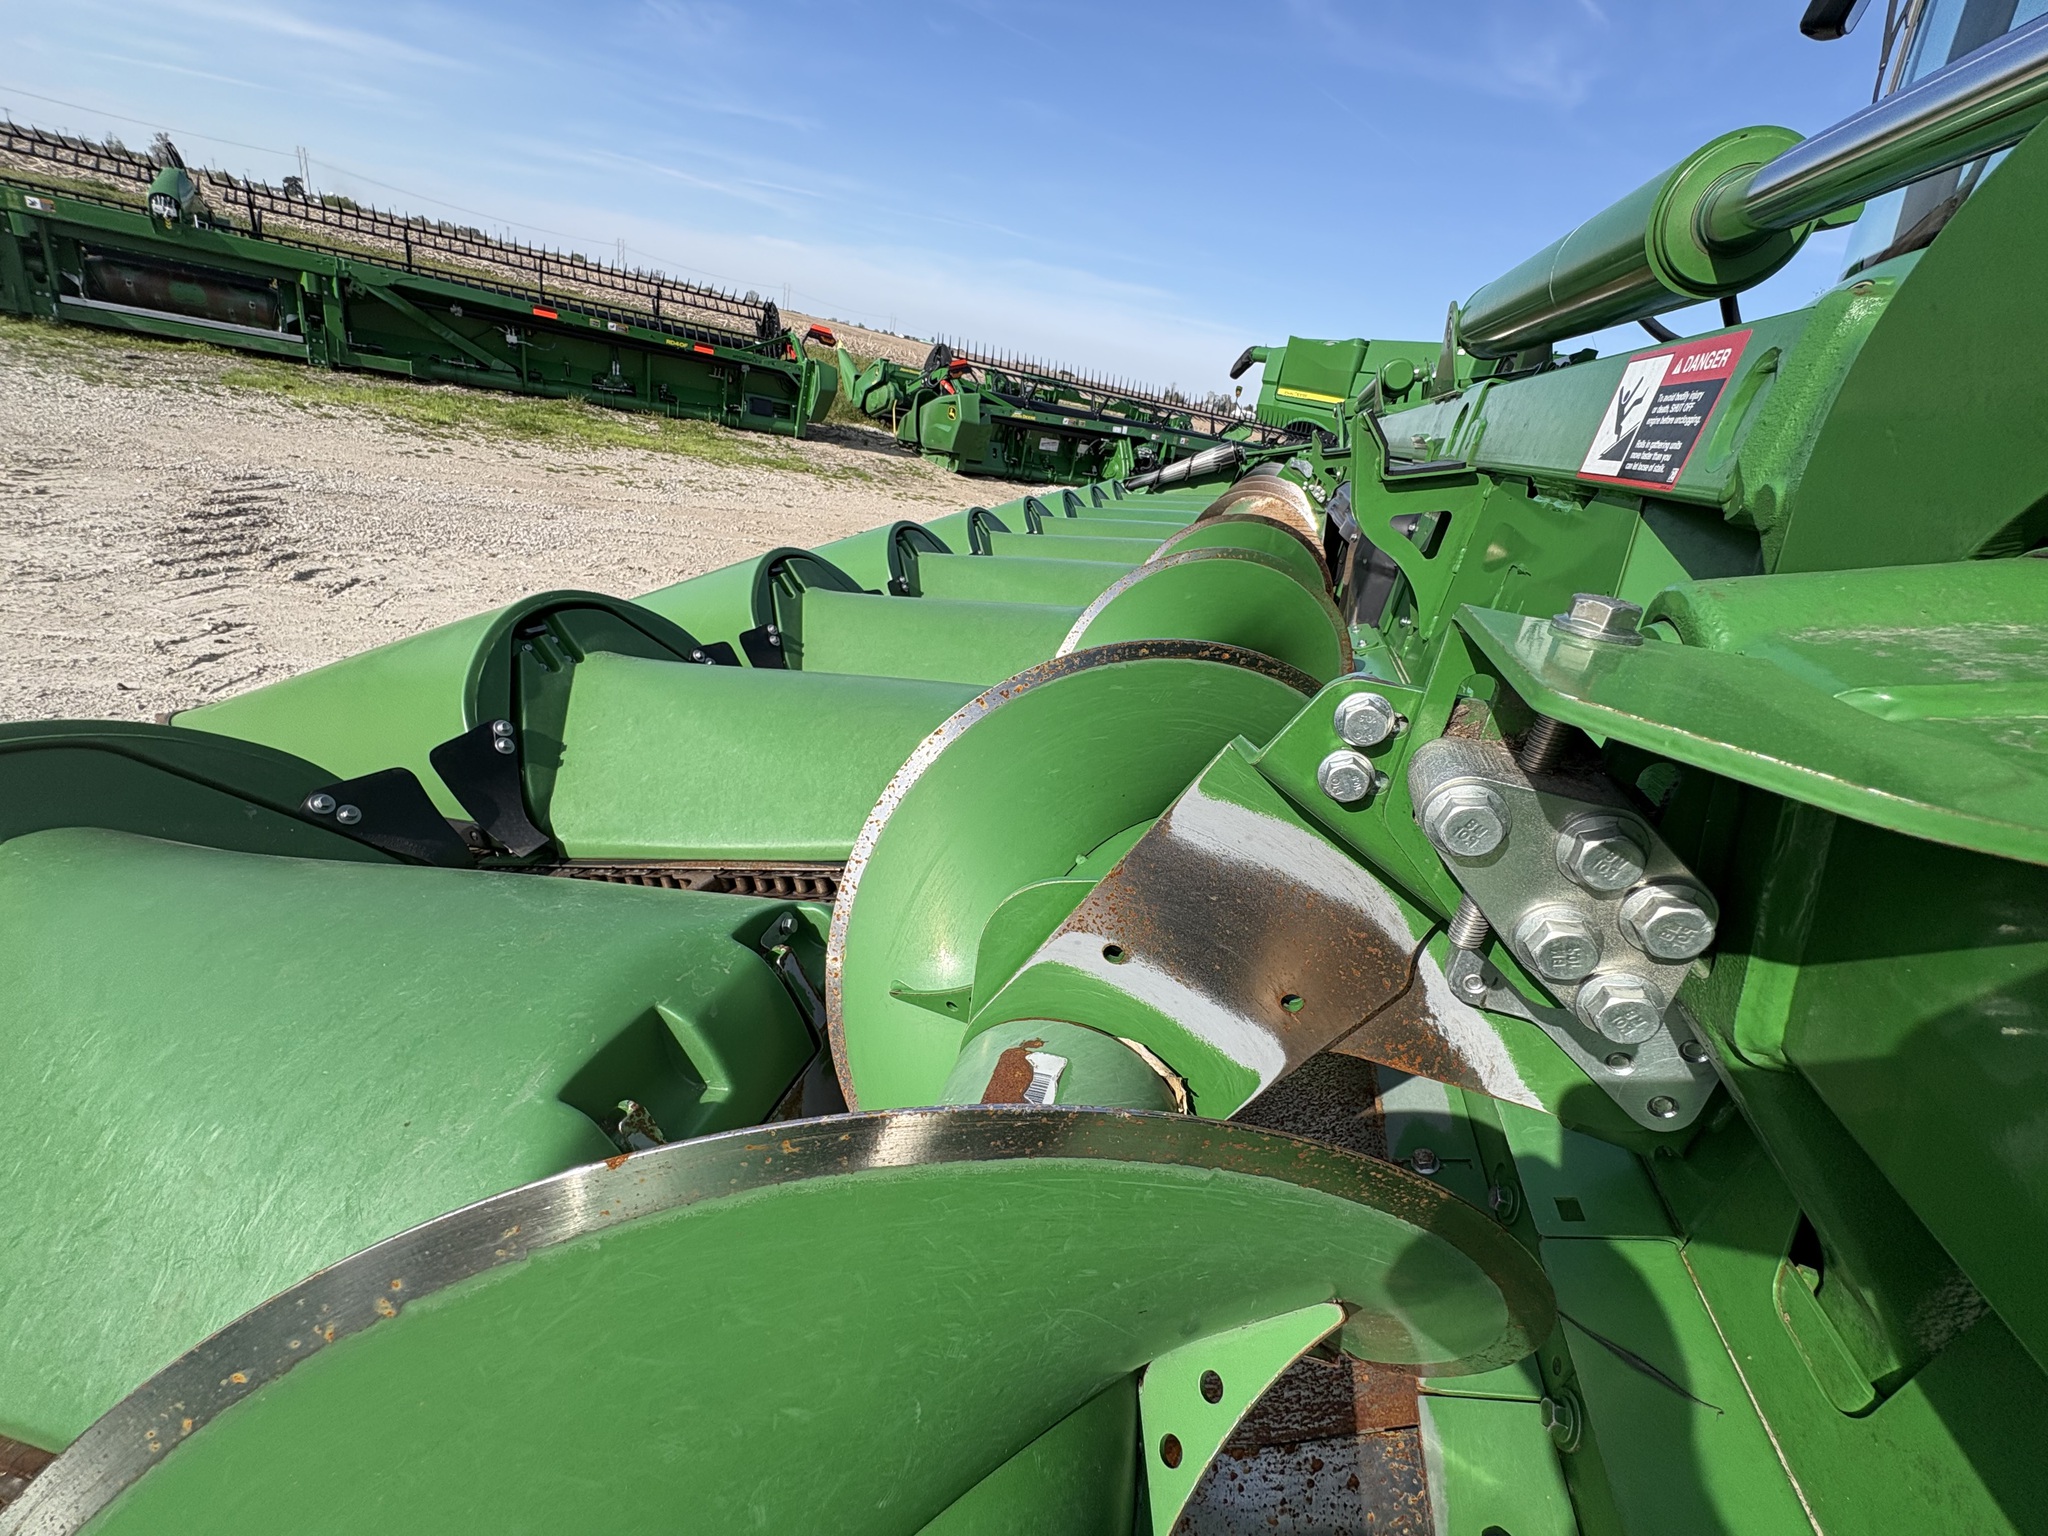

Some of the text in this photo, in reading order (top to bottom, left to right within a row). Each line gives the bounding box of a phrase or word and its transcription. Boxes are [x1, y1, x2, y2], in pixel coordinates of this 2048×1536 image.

[1682, 348, 1732, 374] DANGER
[1663, 392, 1678, 403] avoid
[1689, 390, 1705, 402] injury
[1670, 402, 1685, 413] SHUT
[1683, 401, 1696, 412] OFF
[1646, 416, 1662, 427] engine
[1660, 415, 1675, 425] before
